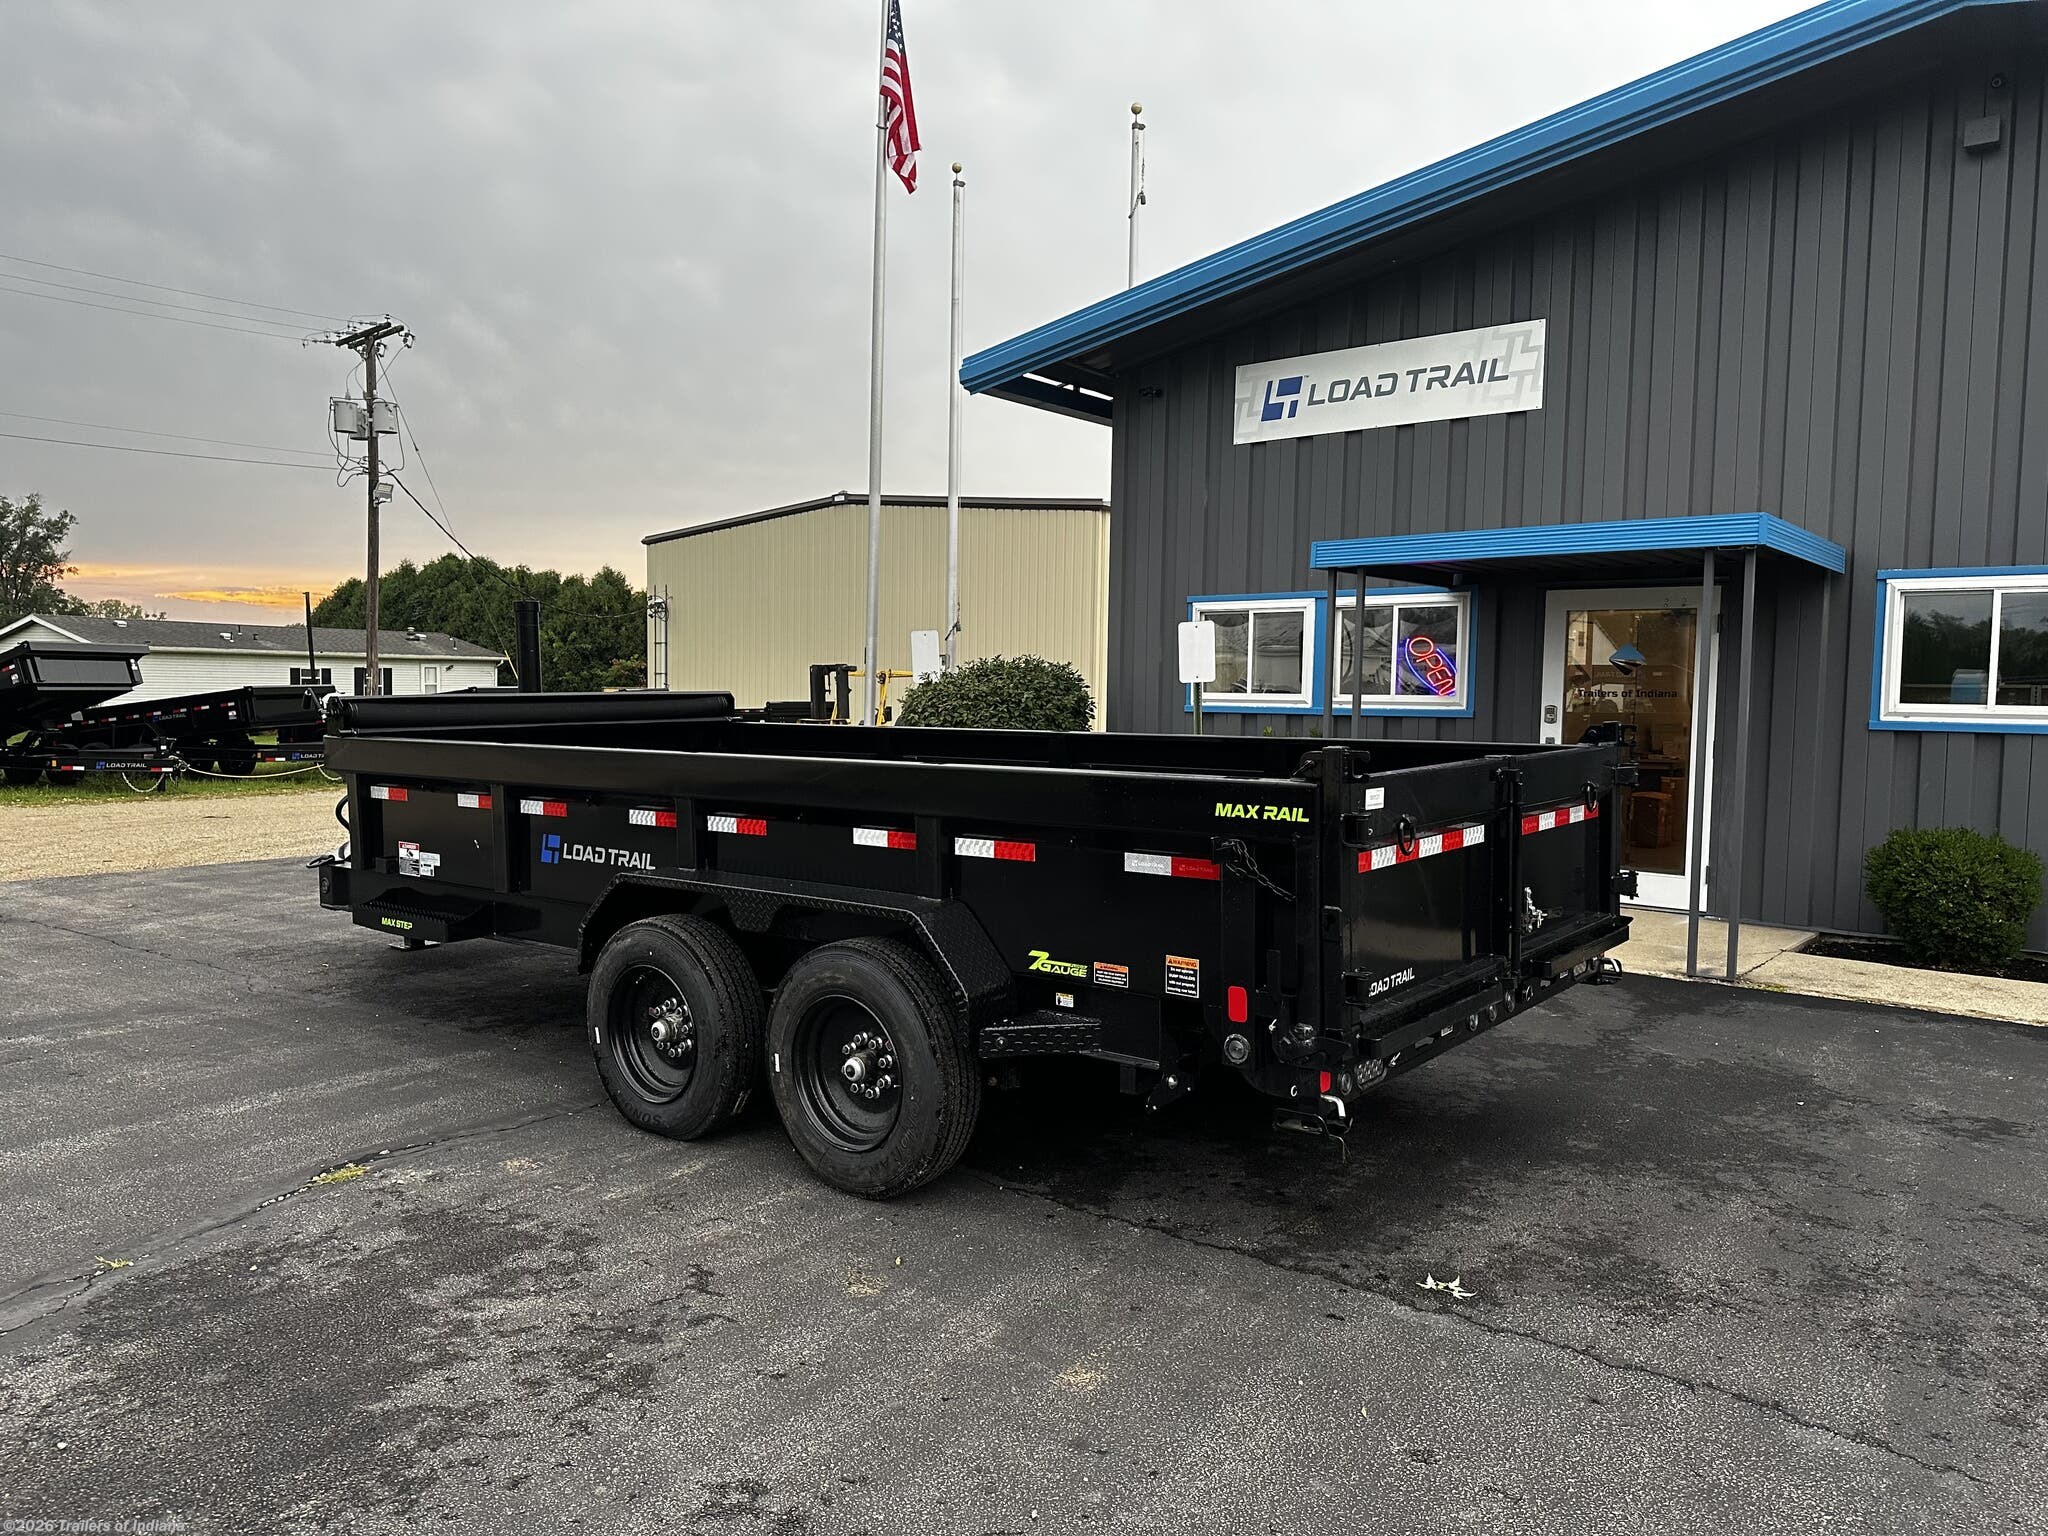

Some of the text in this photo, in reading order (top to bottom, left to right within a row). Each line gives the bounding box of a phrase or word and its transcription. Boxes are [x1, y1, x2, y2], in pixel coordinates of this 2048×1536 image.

[1307, 358, 1509, 406] LOAD TRAIL
[1409, 637, 1456, 696] OPEN
[1578, 689, 1677, 698] Trailers of Indiana
[1215, 803, 1309, 822] MAX RAIL
[563, 843, 656, 870] LOAD TRAIL
[381, 917, 413, 930] MAX STEP
[1028, 950, 1049, 970] 7
[1038, 960, 1088, 978] GAUGE
[1368, 967, 1415, 997] OAD TRAIL
